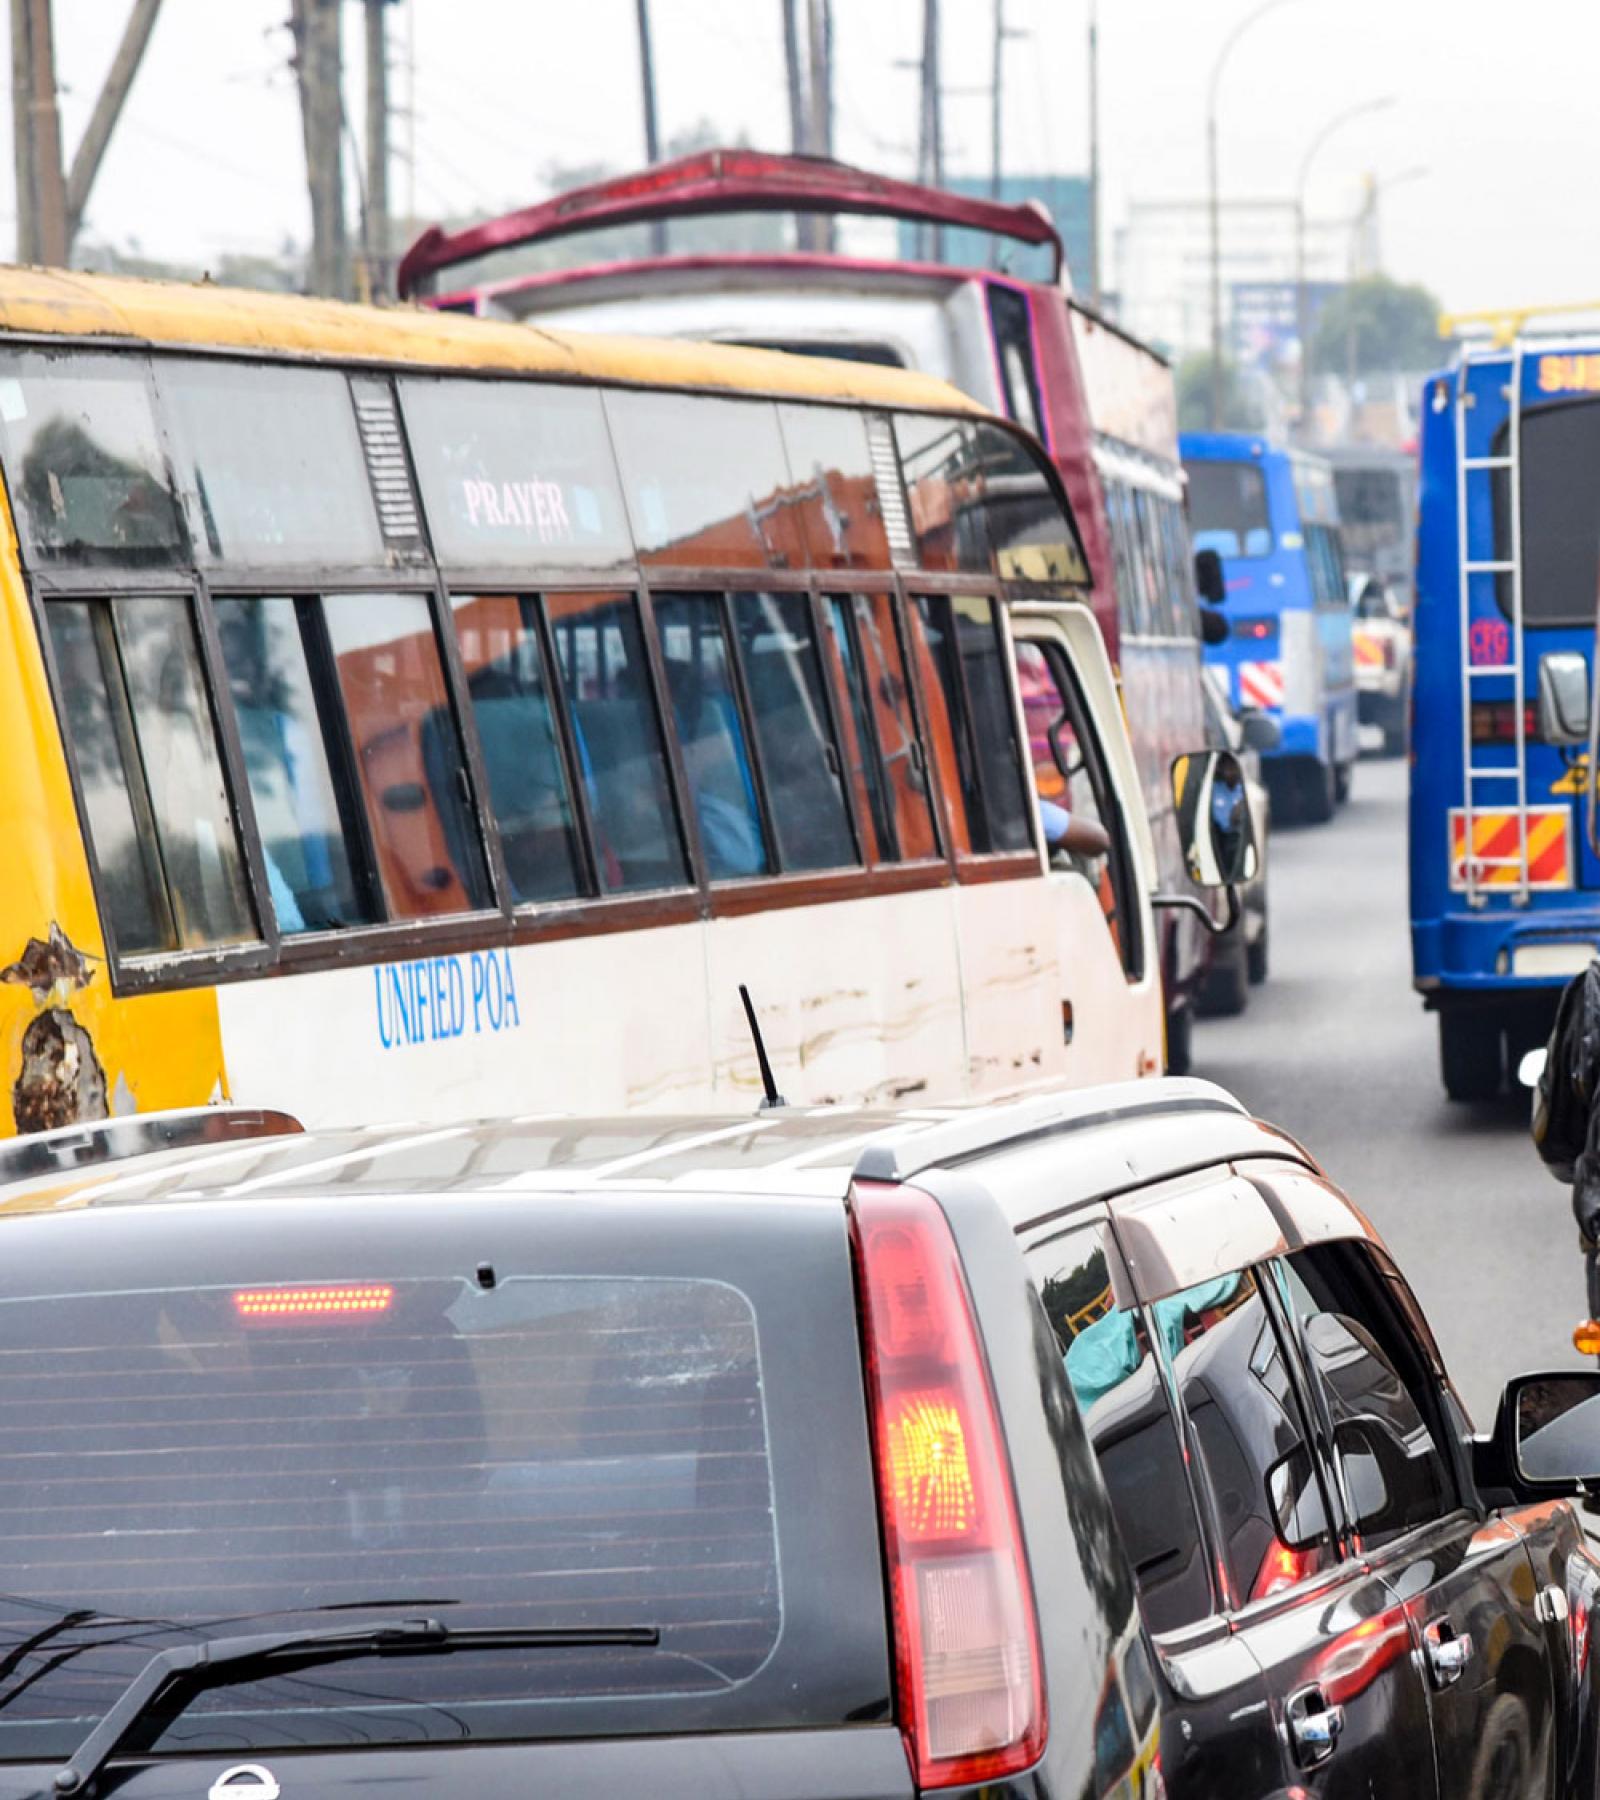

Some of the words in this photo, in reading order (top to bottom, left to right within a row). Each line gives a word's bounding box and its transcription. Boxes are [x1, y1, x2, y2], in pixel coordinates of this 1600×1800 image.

[462, 479, 569, 528] PRAYER
[373, 951, 465, 1049] UNIFIED
[470, 946, 520, 1032] POA
